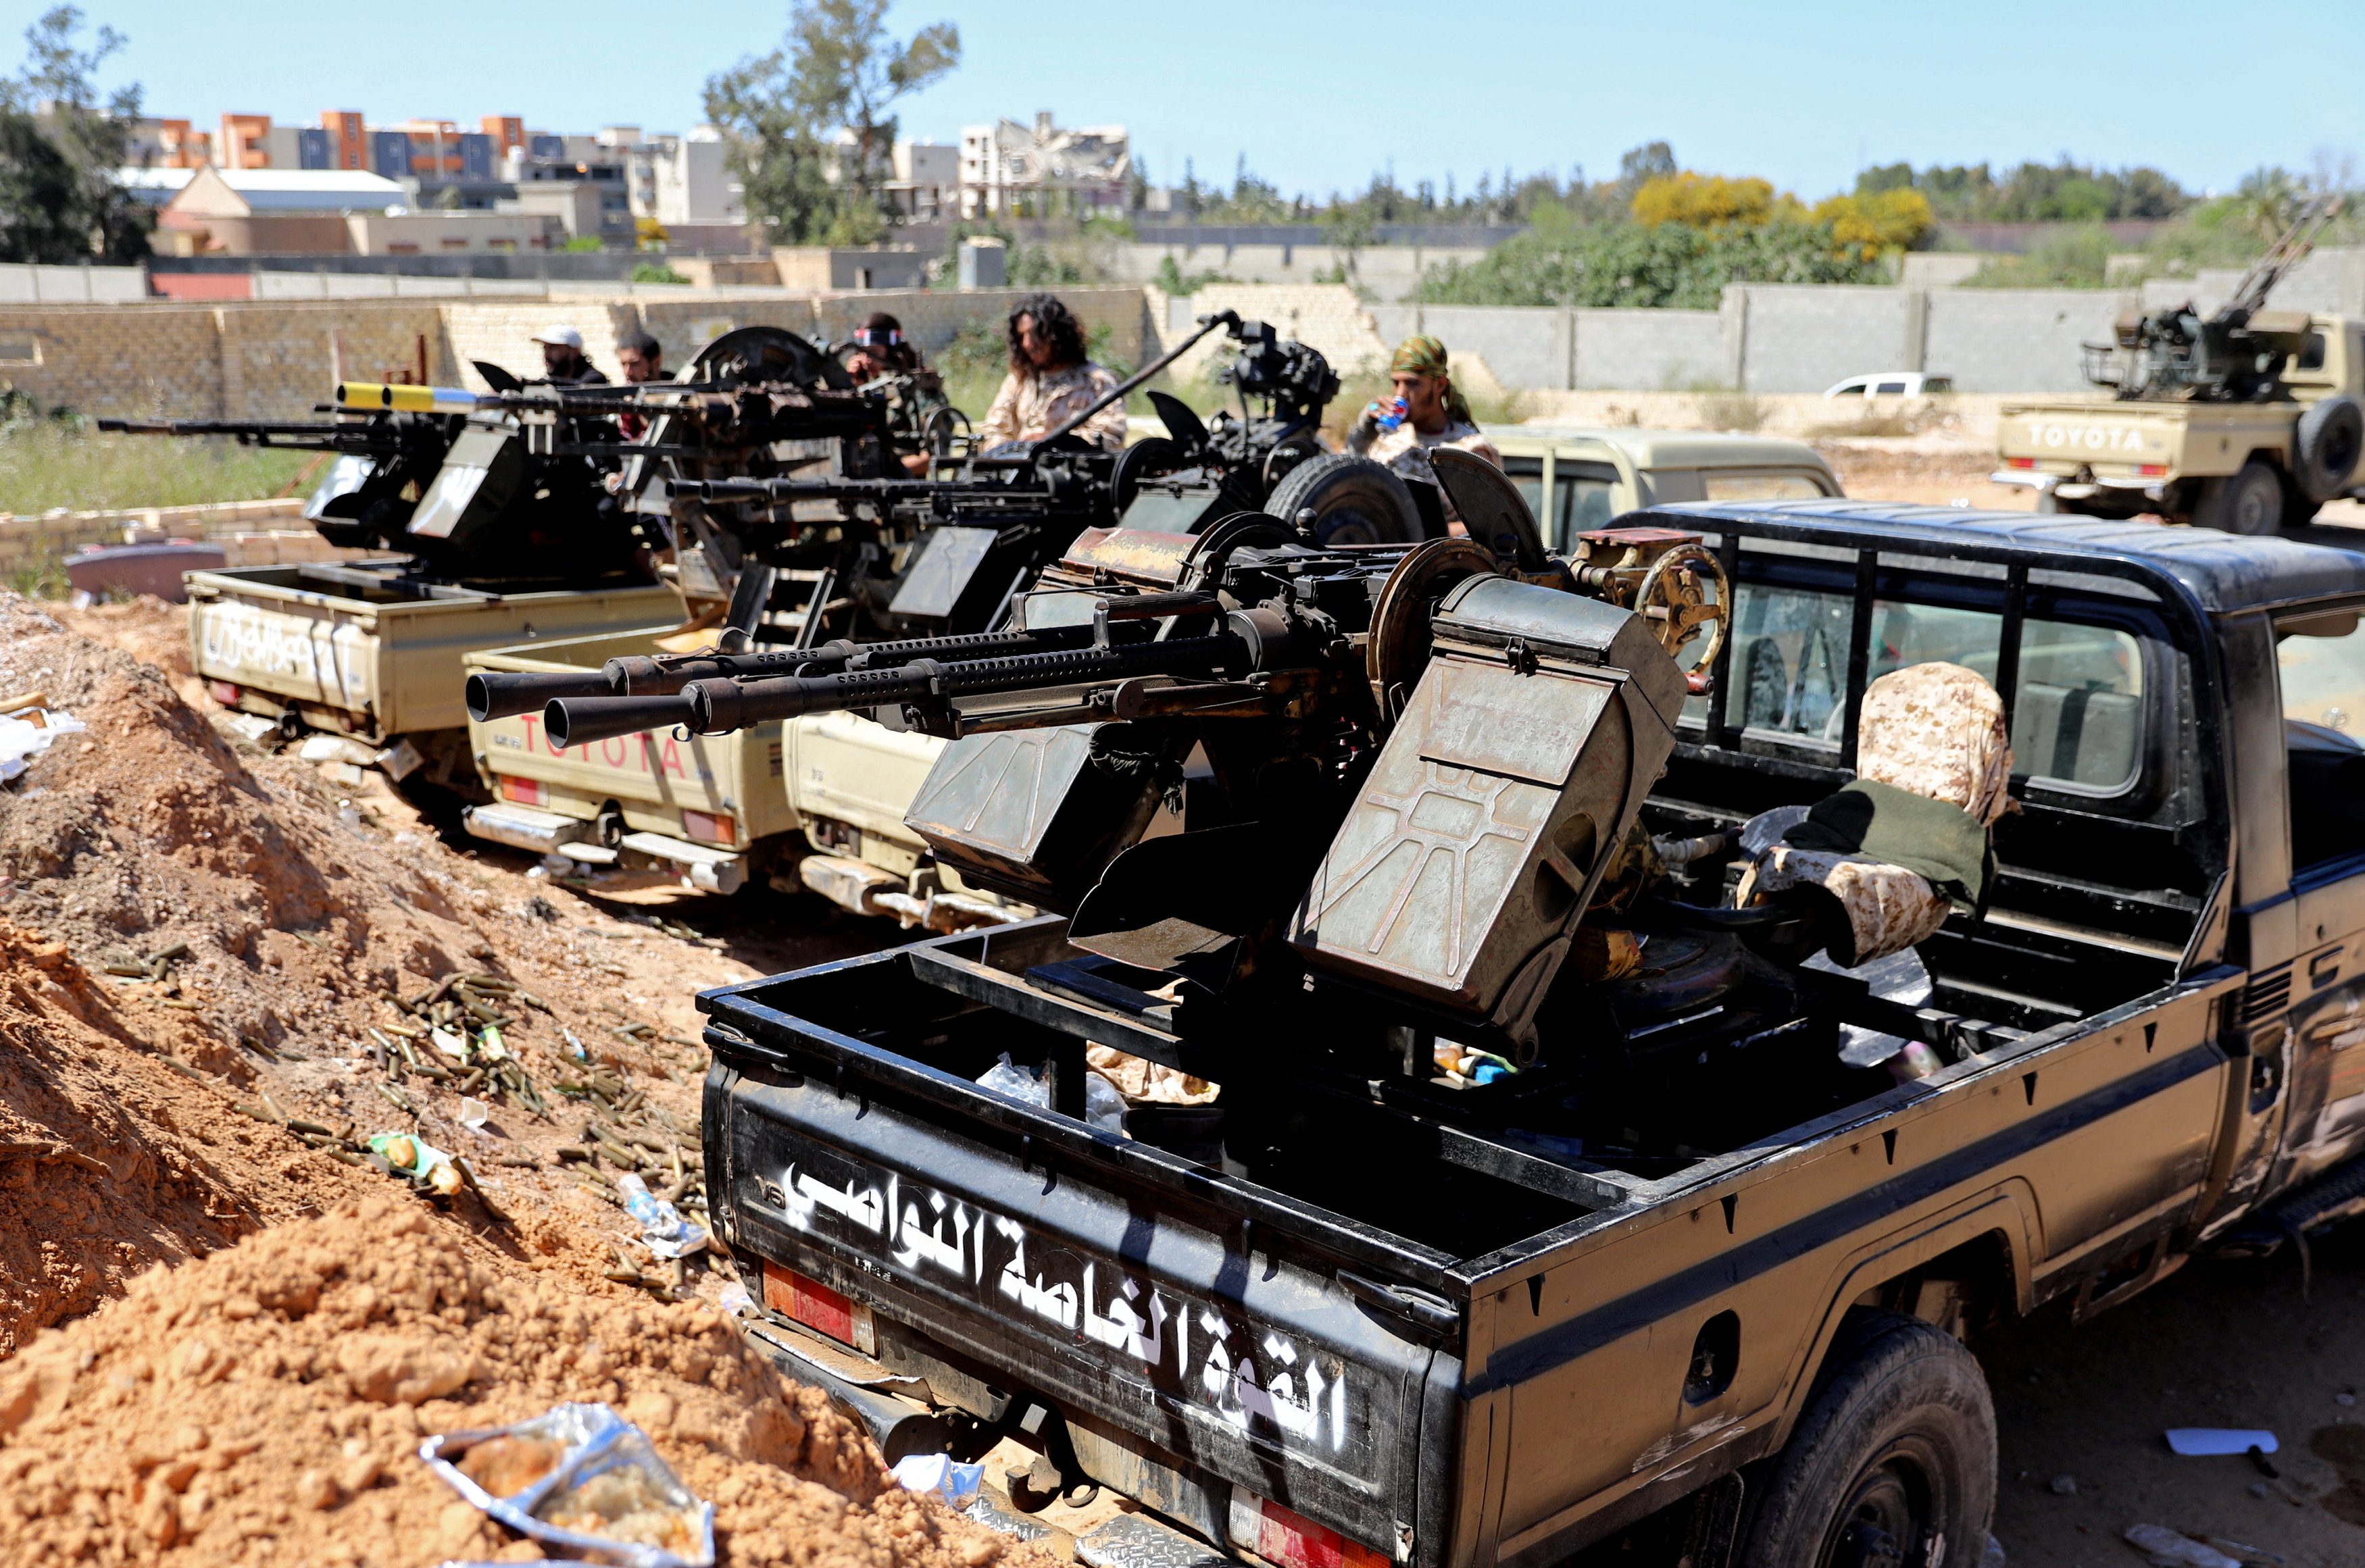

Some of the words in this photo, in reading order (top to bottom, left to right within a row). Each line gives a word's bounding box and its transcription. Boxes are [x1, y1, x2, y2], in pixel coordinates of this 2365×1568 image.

[2029, 425, 2144, 451] TOYOTA
[754, 1175, 786, 1210] V6
[780, 1161, 985, 1285] النواصي
[996, 1216, 1189, 1380] الخاصة
[1200, 1311, 1345, 1452] القوة
